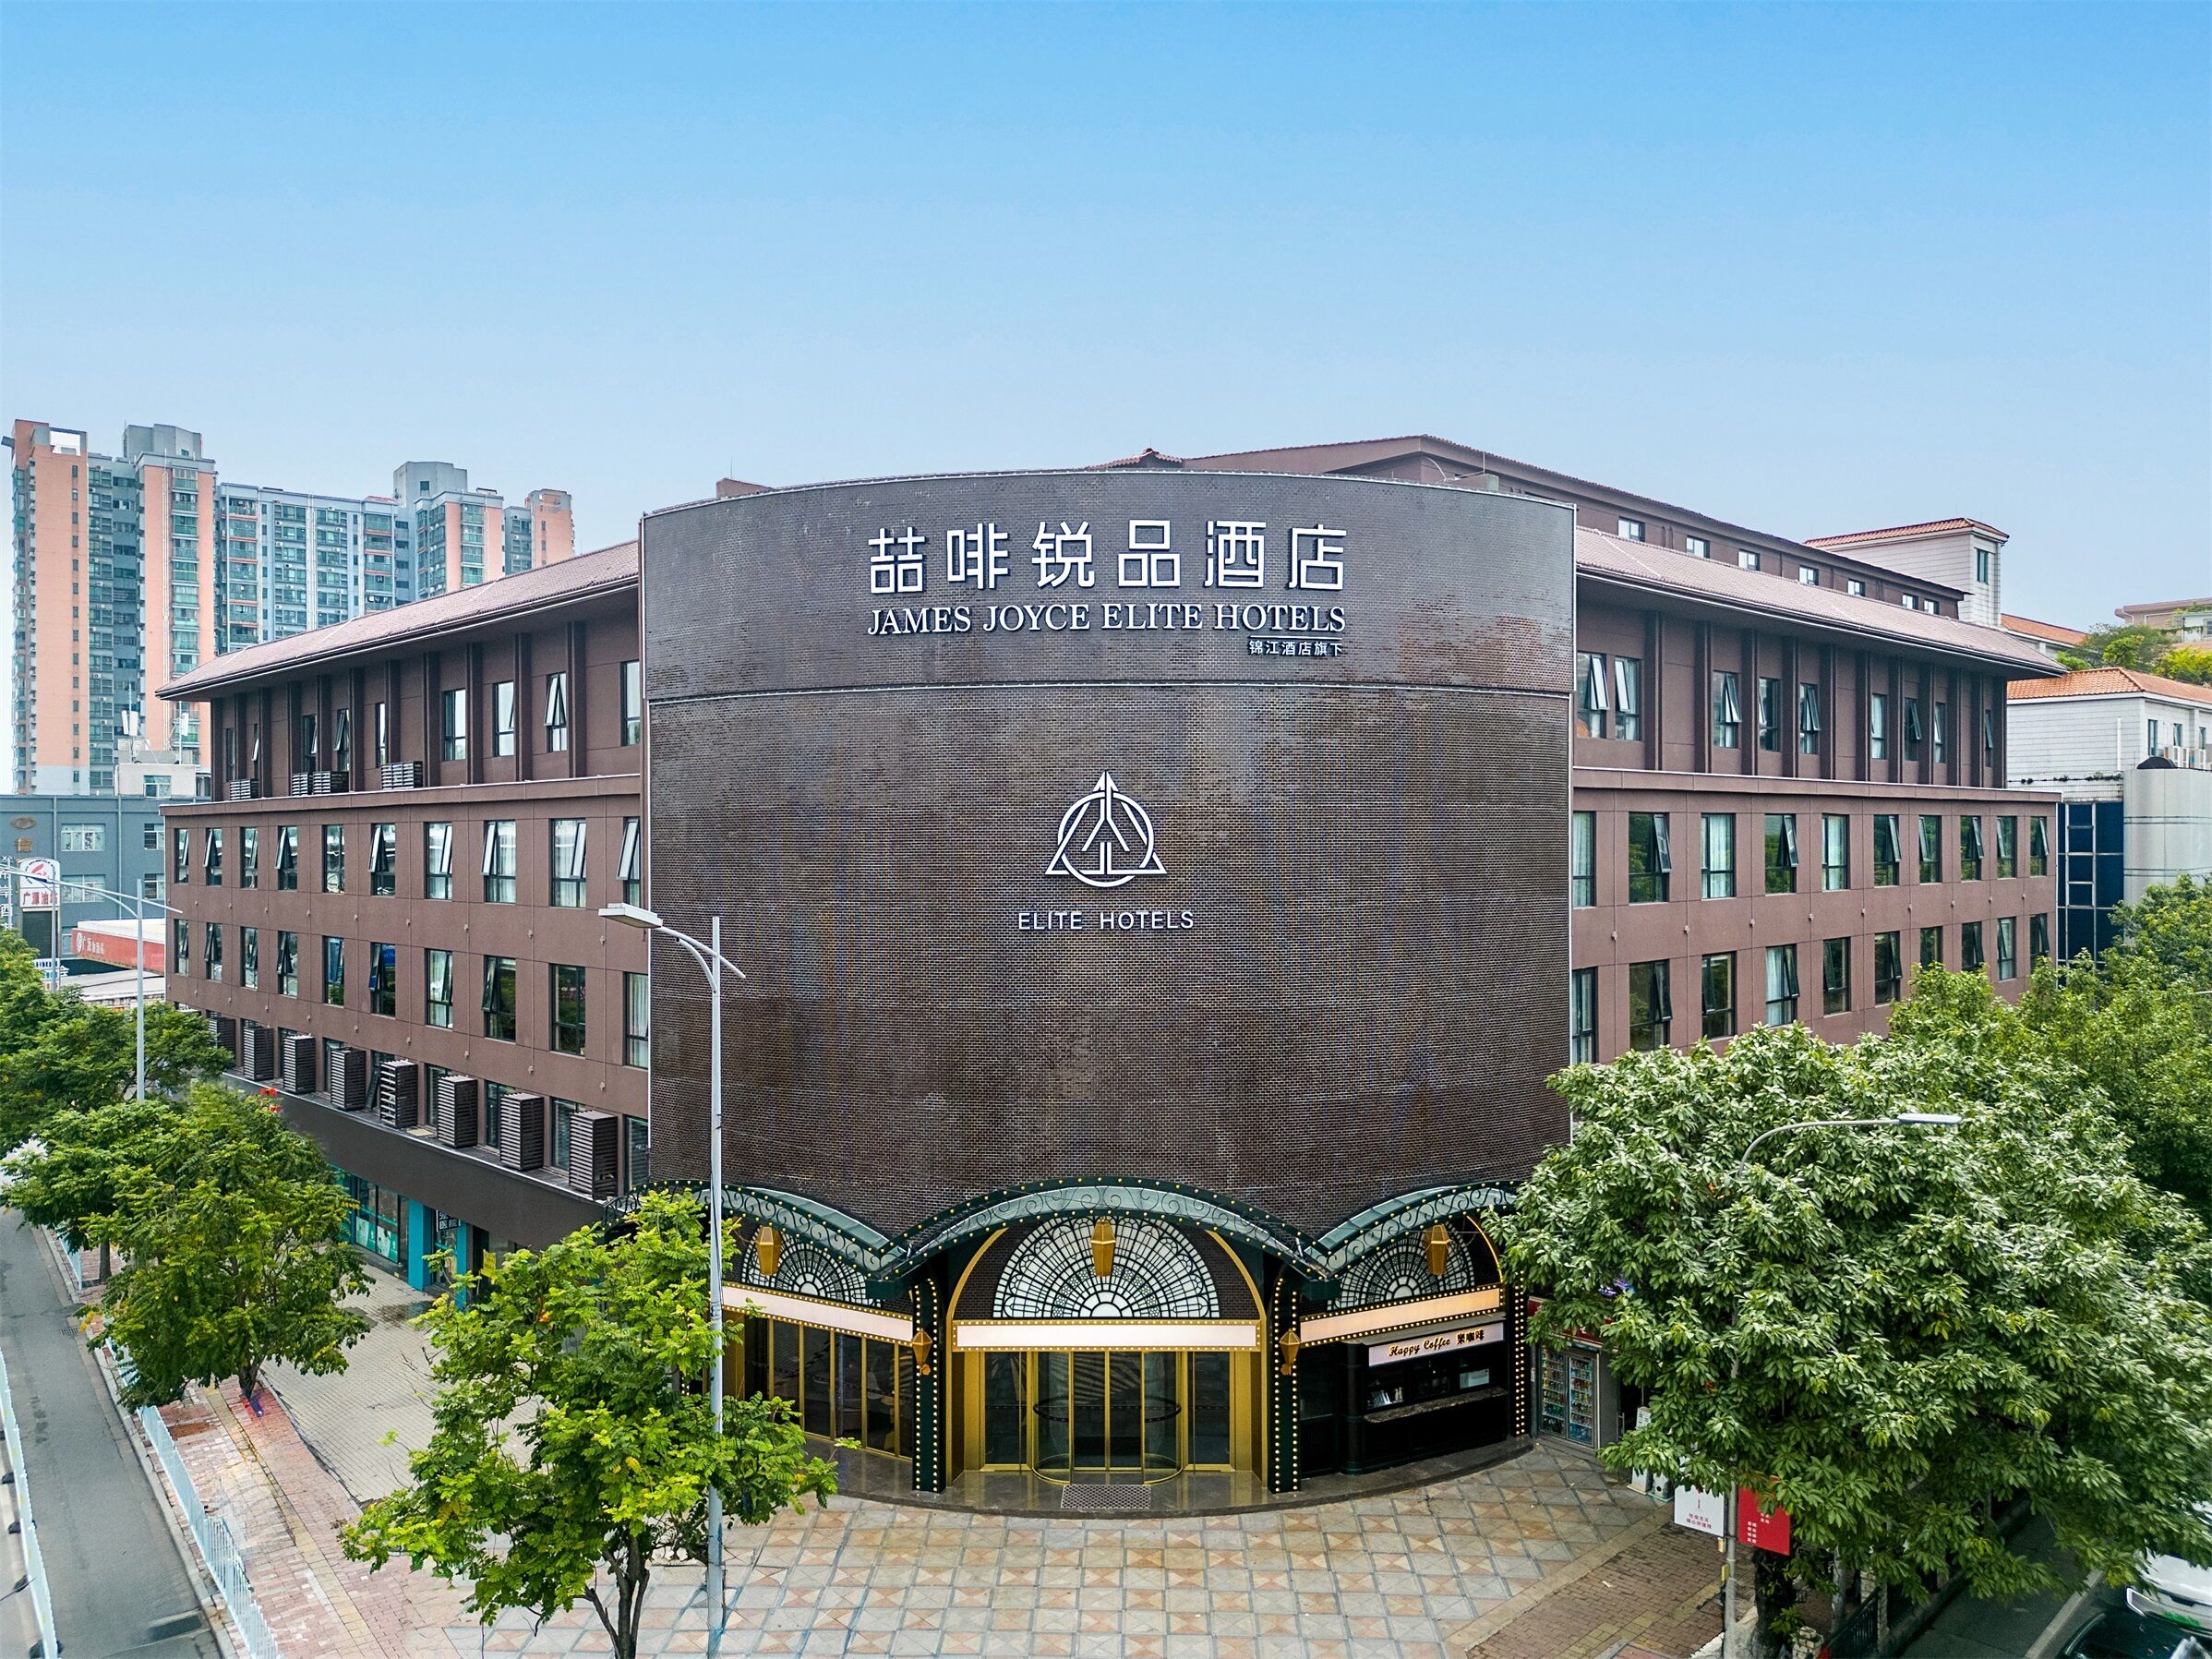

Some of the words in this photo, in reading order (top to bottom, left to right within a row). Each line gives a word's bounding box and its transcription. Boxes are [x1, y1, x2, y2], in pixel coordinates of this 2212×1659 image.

[868, 520, 1347, 594] 喆啡锐品酒店
[868, 606, 971, 635] JAMES
[983, 603, 1090, 632] JOYCE
[1101, 603, 1203, 631] ELITE
[1214, 603, 1346, 632] HOTELS
[1249, 640, 1343, 656] 锦江酒店旗下
[1018, 911, 1083, 930] ELITE
[1100, 910, 1195, 930] HOTELS
[1389, 1345, 1420, 1356] Happy
[1424, 1338, 1450, 1351] Coffee
